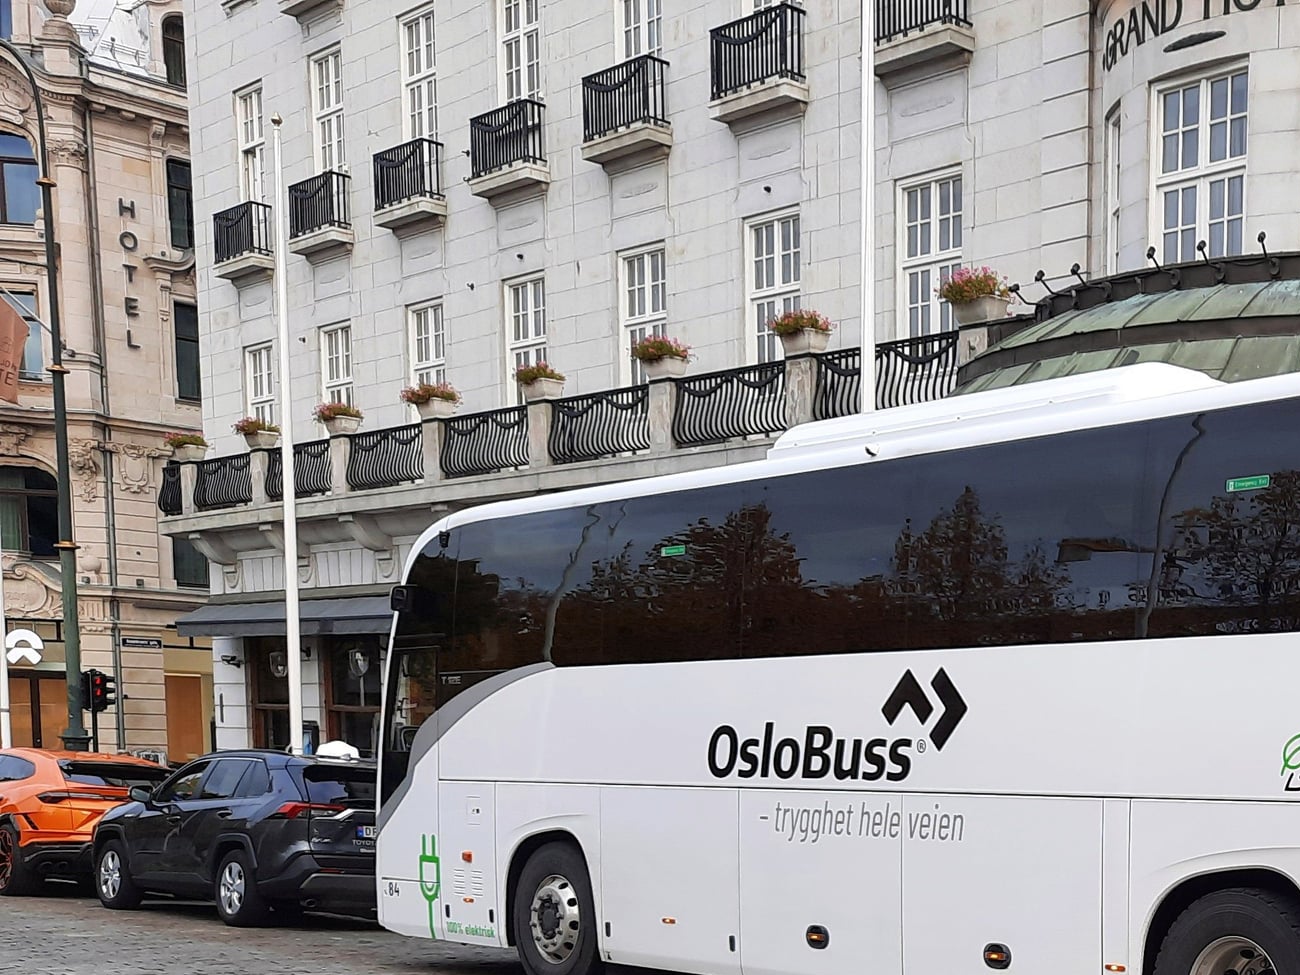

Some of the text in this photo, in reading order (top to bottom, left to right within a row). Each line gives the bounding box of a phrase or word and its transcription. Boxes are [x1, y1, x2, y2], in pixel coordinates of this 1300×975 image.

[1102, 0, 1183, 73] GRAND
[118, 197, 141, 348] HOTEL
[774, 800, 854, 843] trygghet
[858, 801, 900, 838] hele
[908, 803, 965, 841] veien
[388, 882, 400, 897] 84
[465, 924, 495, 938] elektrisk
